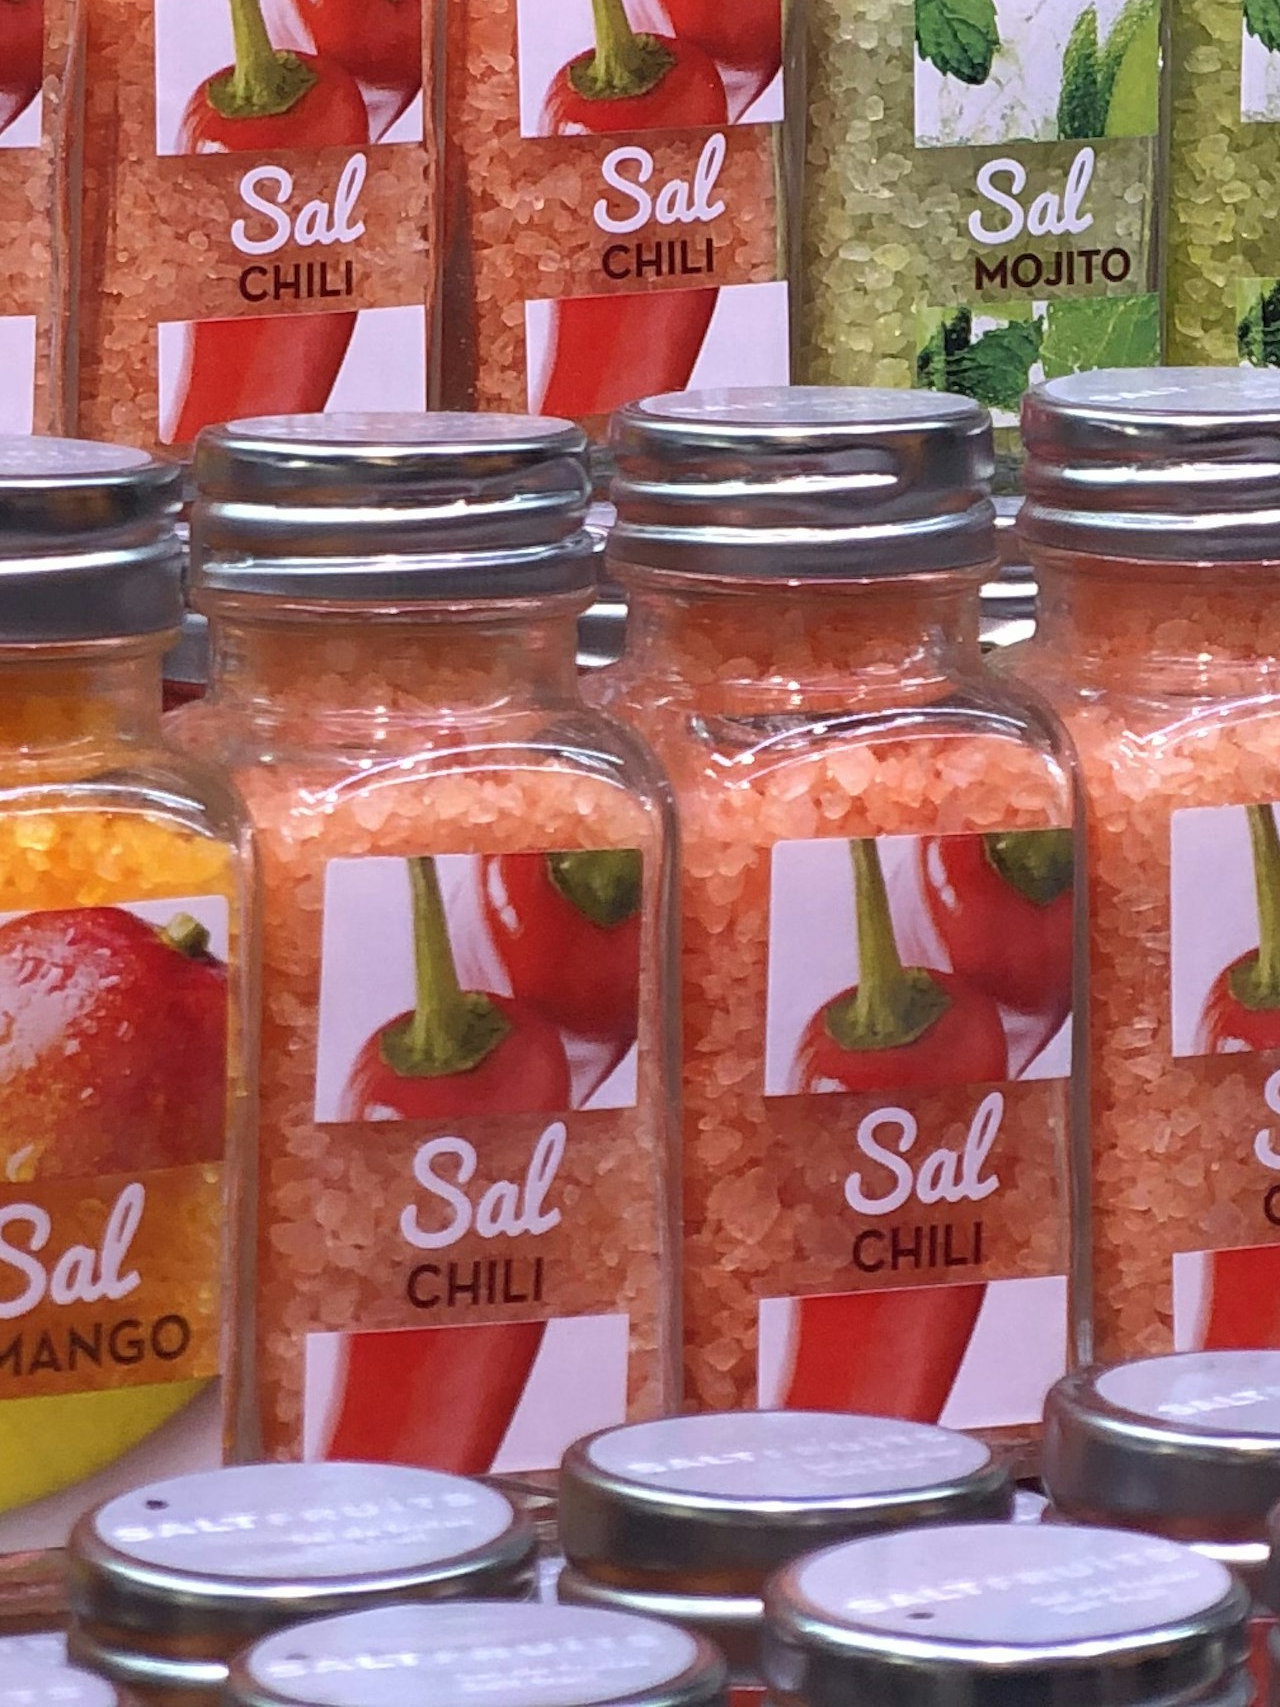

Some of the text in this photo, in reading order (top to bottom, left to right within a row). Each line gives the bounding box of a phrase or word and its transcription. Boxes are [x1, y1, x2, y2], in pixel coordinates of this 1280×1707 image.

[230, 153, 368, 254] Sal
[593, 133, 726, 234] Sal
[967, 147, 1095, 245] Sal
[238, 262, 354, 304] CHILI
[601, 240, 717, 281] CHILI
[974, 248, 1131, 291] MOJITO
[400, 1122, 569, 1250] Sal
[844, 1091, 1004, 1216] Sal
[852, 1219, 984, 1273] CHILI
[406, 1262, 544, 1310] CHILI
